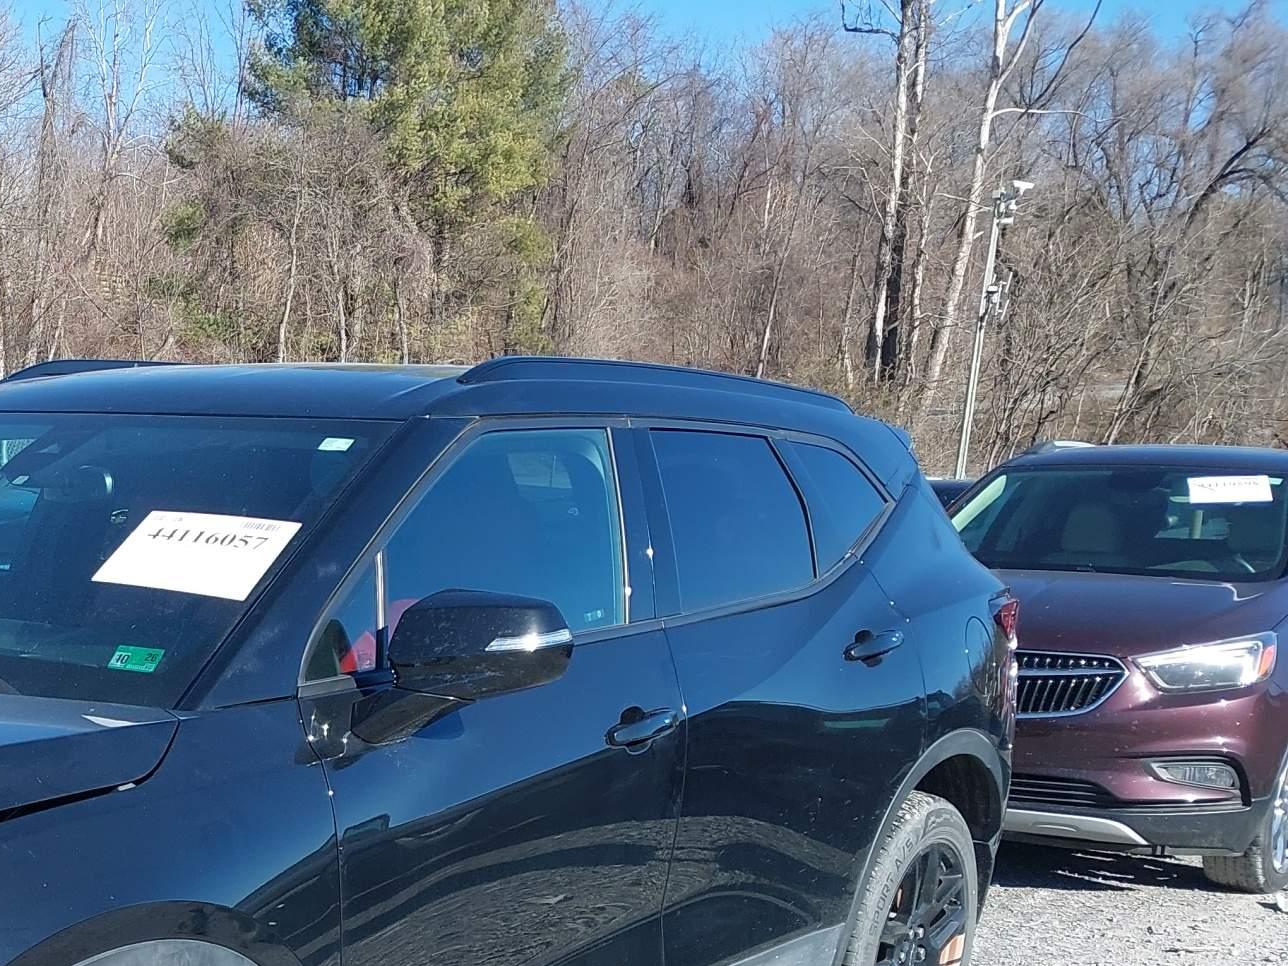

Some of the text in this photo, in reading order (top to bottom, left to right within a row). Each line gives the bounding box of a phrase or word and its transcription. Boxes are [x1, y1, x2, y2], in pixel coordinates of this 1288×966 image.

[148, 527, 269, 550] 44116057
[115, 653, 130, 664] 10
[868, 836, 914, 937] SPORT A/S
